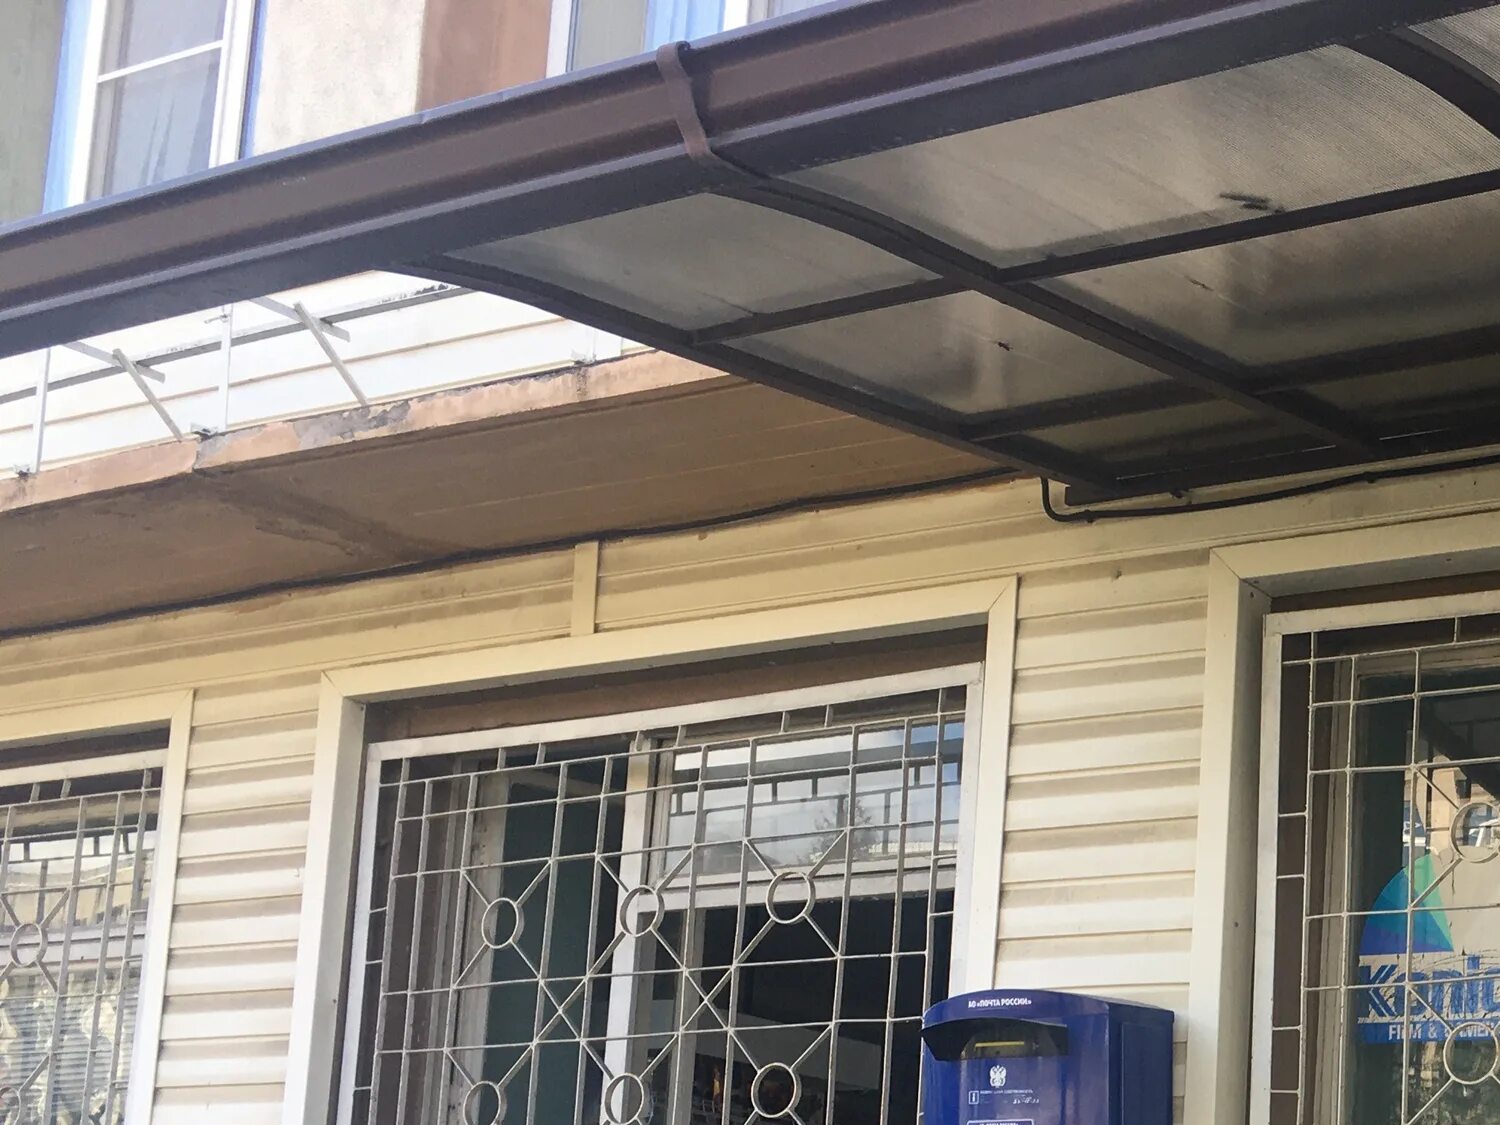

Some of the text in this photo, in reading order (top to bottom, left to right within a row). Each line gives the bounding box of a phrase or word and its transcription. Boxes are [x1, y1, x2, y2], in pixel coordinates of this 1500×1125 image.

[967, 997, 1032, 1009] АО «ПОЧТА РОССИИ»
[1388, 1023, 1422, 1041] FIM
[1427, 1023, 1438, 1039] &
